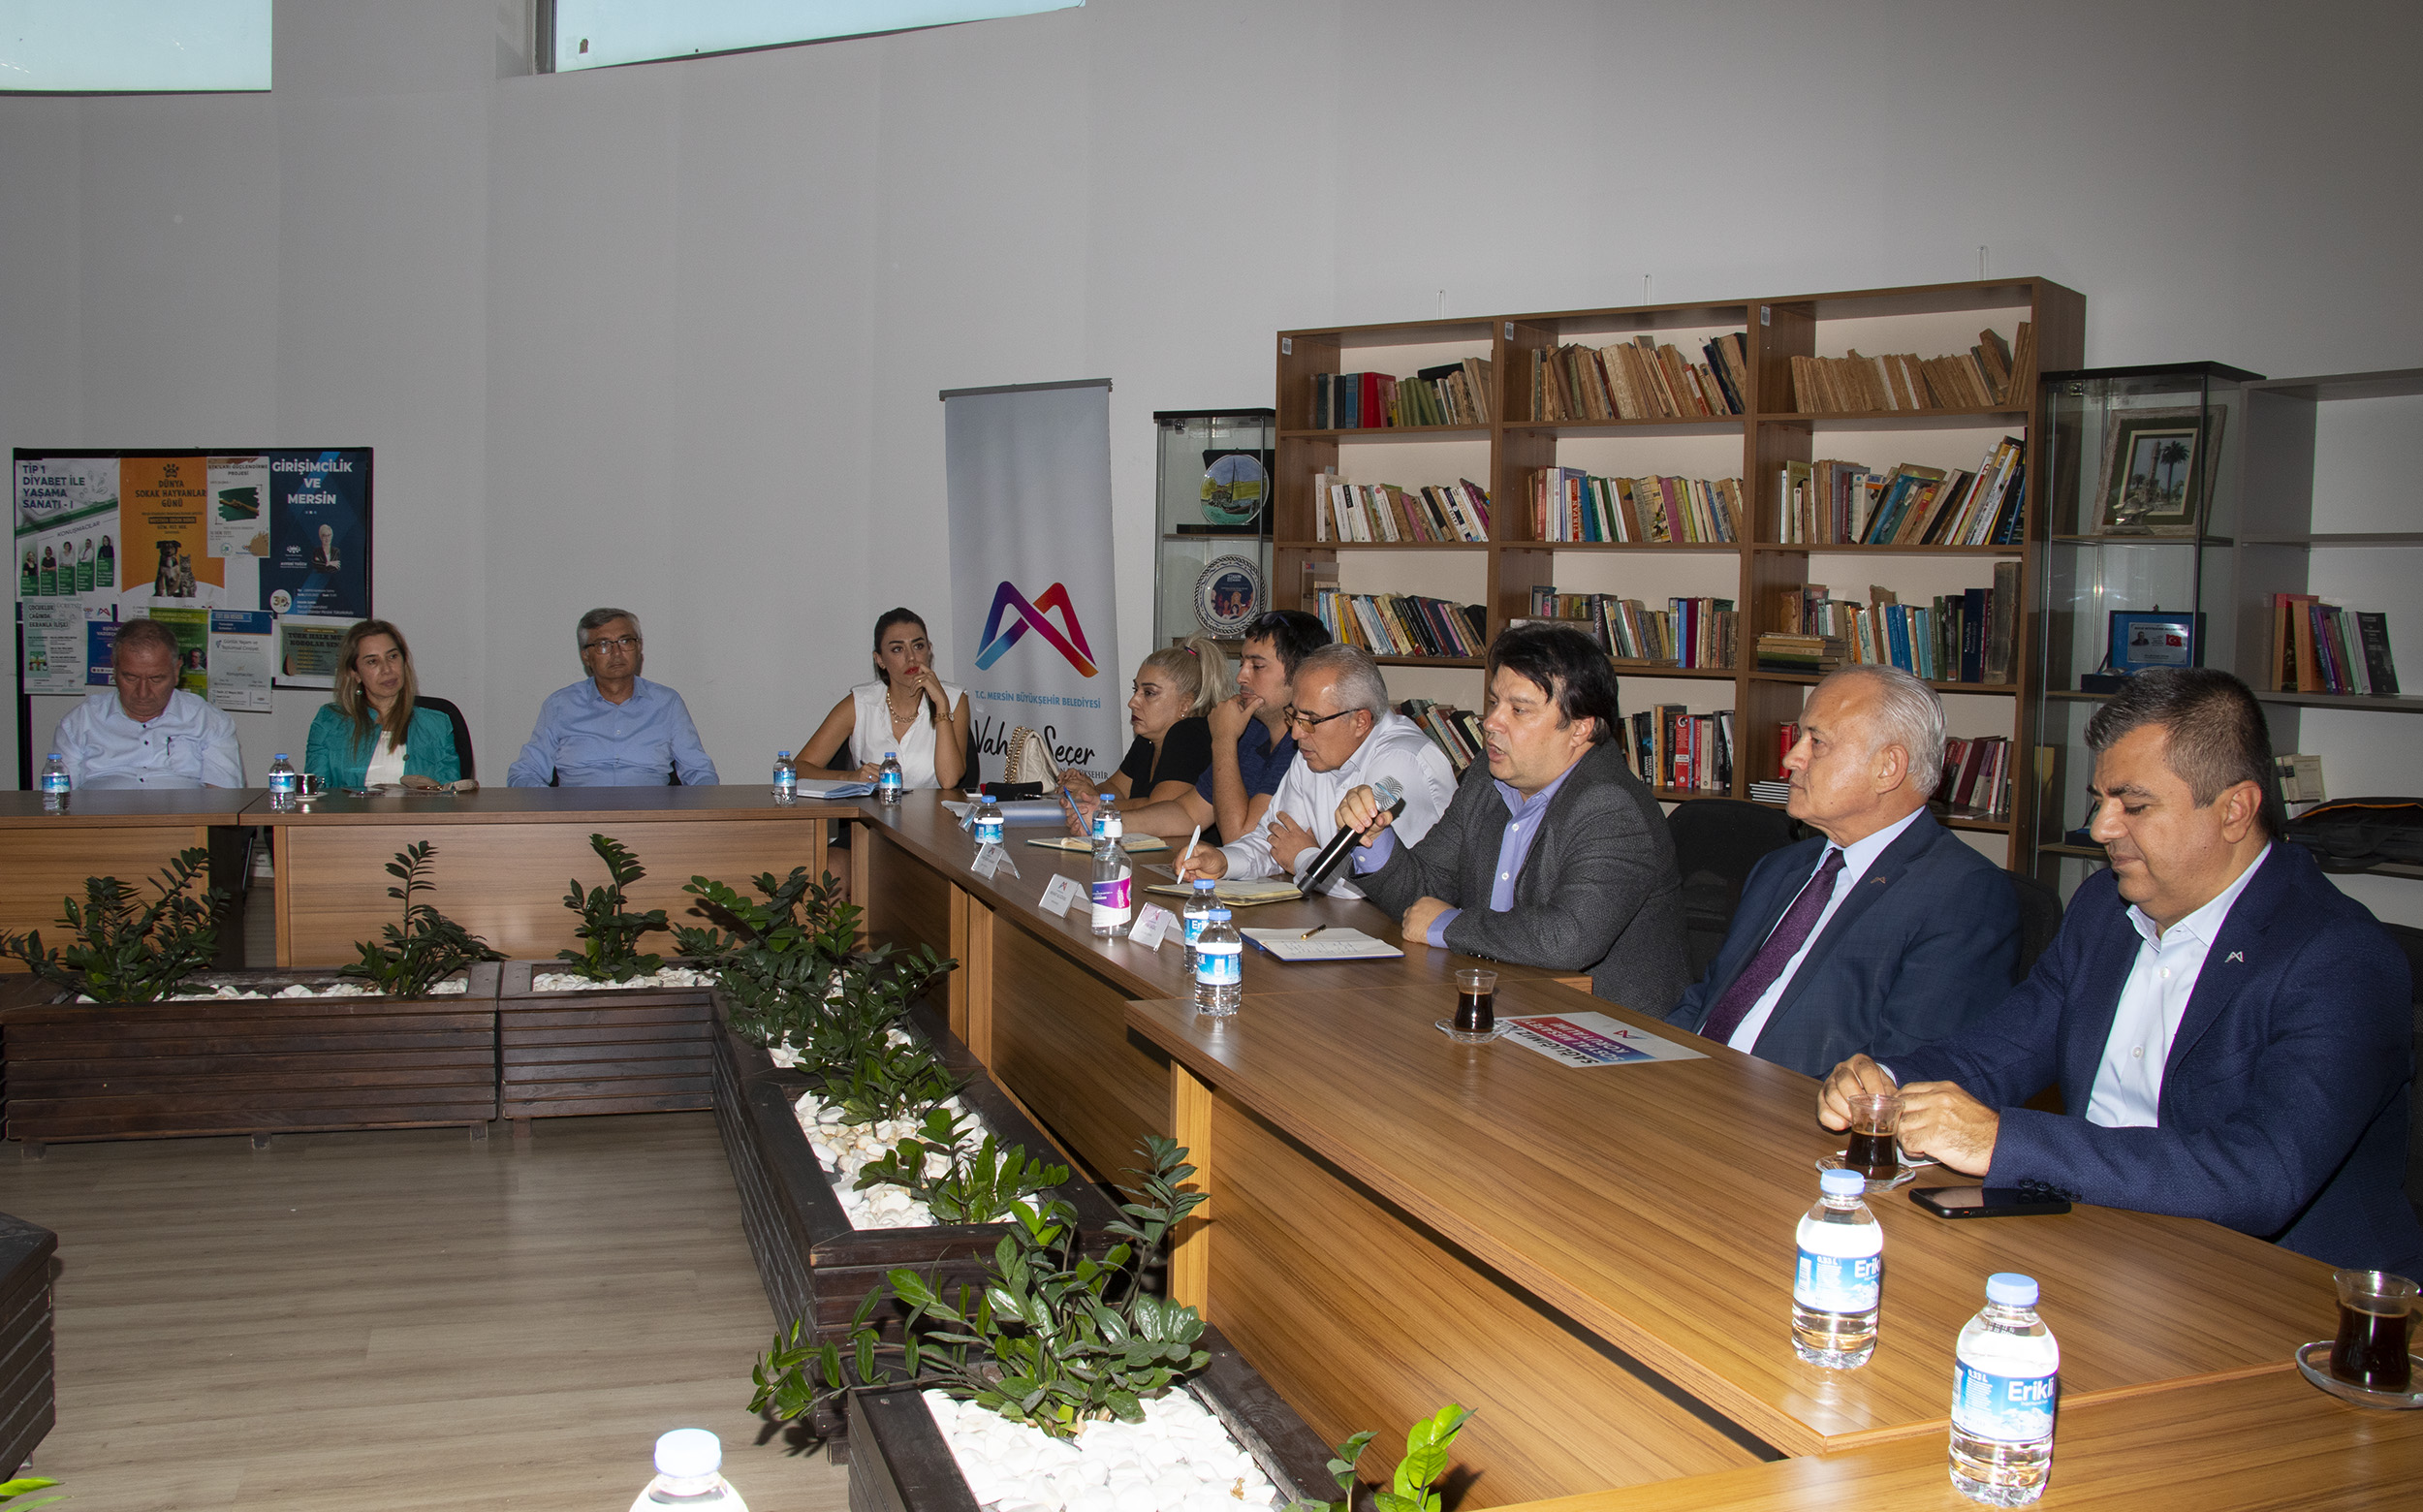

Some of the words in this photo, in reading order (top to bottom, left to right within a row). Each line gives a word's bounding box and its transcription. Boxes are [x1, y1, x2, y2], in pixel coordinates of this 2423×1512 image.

[22, 462, 38, 474] TİP
[41, 465, 46, 474] 1
[271, 458, 353, 475] GİRİŞİMCİLİK
[22, 474, 67, 486] DİYABET
[70, 474, 85, 486] İLE
[158, 479, 184, 488] DÜNYA
[303, 478, 321, 488] VE
[22, 488, 68, 499] YAŞAMA
[135, 489, 161, 498] SOKAK
[287, 490, 336, 504] MERSİN
[22, 499, 61, 509] SANATI
[161, 498, 183, 508] GÜNÜ
[975, 690, 987, 700] T.C.
[987, 691, 1015, 702] MERSİN
[1016, 691, 1060, 707] BÜYÜKŞEHİR
[1061, 697, 1101, 709] BELEDİYESİ
[974, 715, 1008, 756] Vah
[1044, 725, 1095, 766] Seçer
[1572, 1040, 1624, 1061] SOSYAL
[1854, 1256, 1880, 1278] Erik
[2007, 1376, 2055, 1402] Erikli
